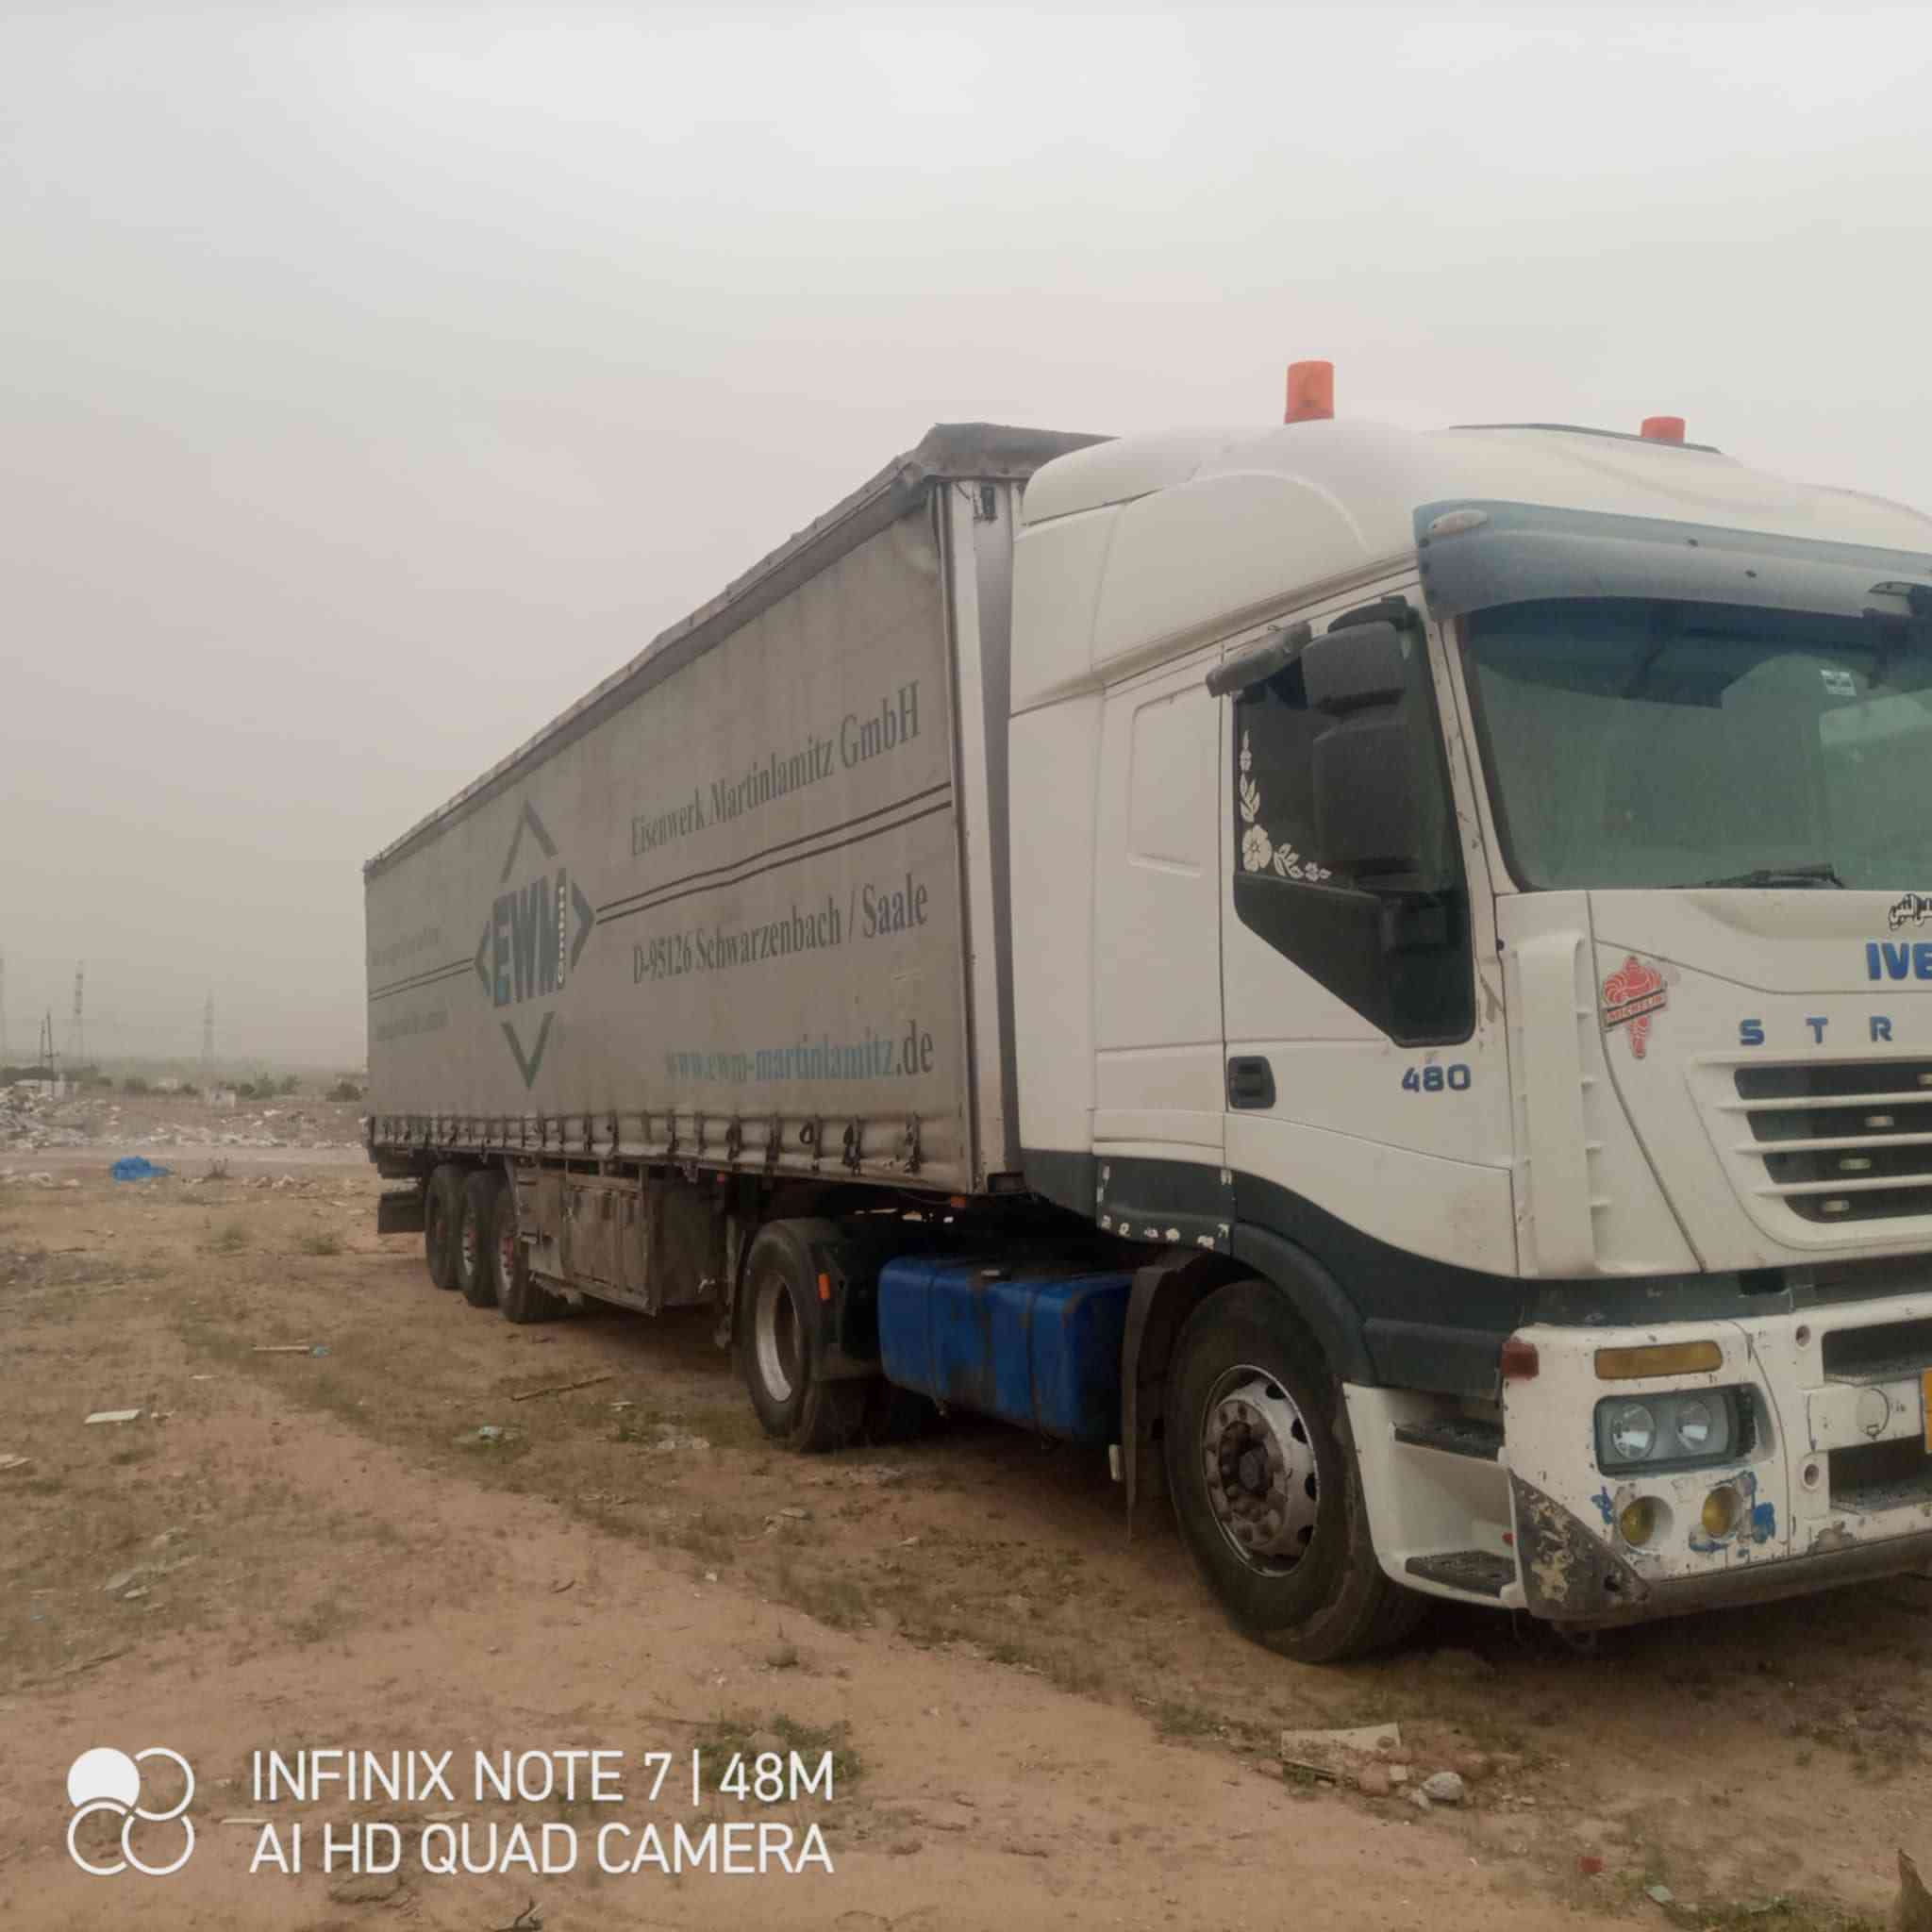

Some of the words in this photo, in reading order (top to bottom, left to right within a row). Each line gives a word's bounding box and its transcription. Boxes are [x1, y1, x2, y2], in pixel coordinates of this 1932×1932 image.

[631, 789, 705, 856] Eisenwerk
[709, 733, 834, 824] Martinlamitz
[840, 679, 921, 769] GmbH
[633, 930, 692, 983] D-95126
[696, 897, 841, 970] Schwarzenbach
[862, 873, 928, 939] Saale
[1402, 1064, 1471, 1092] 480
